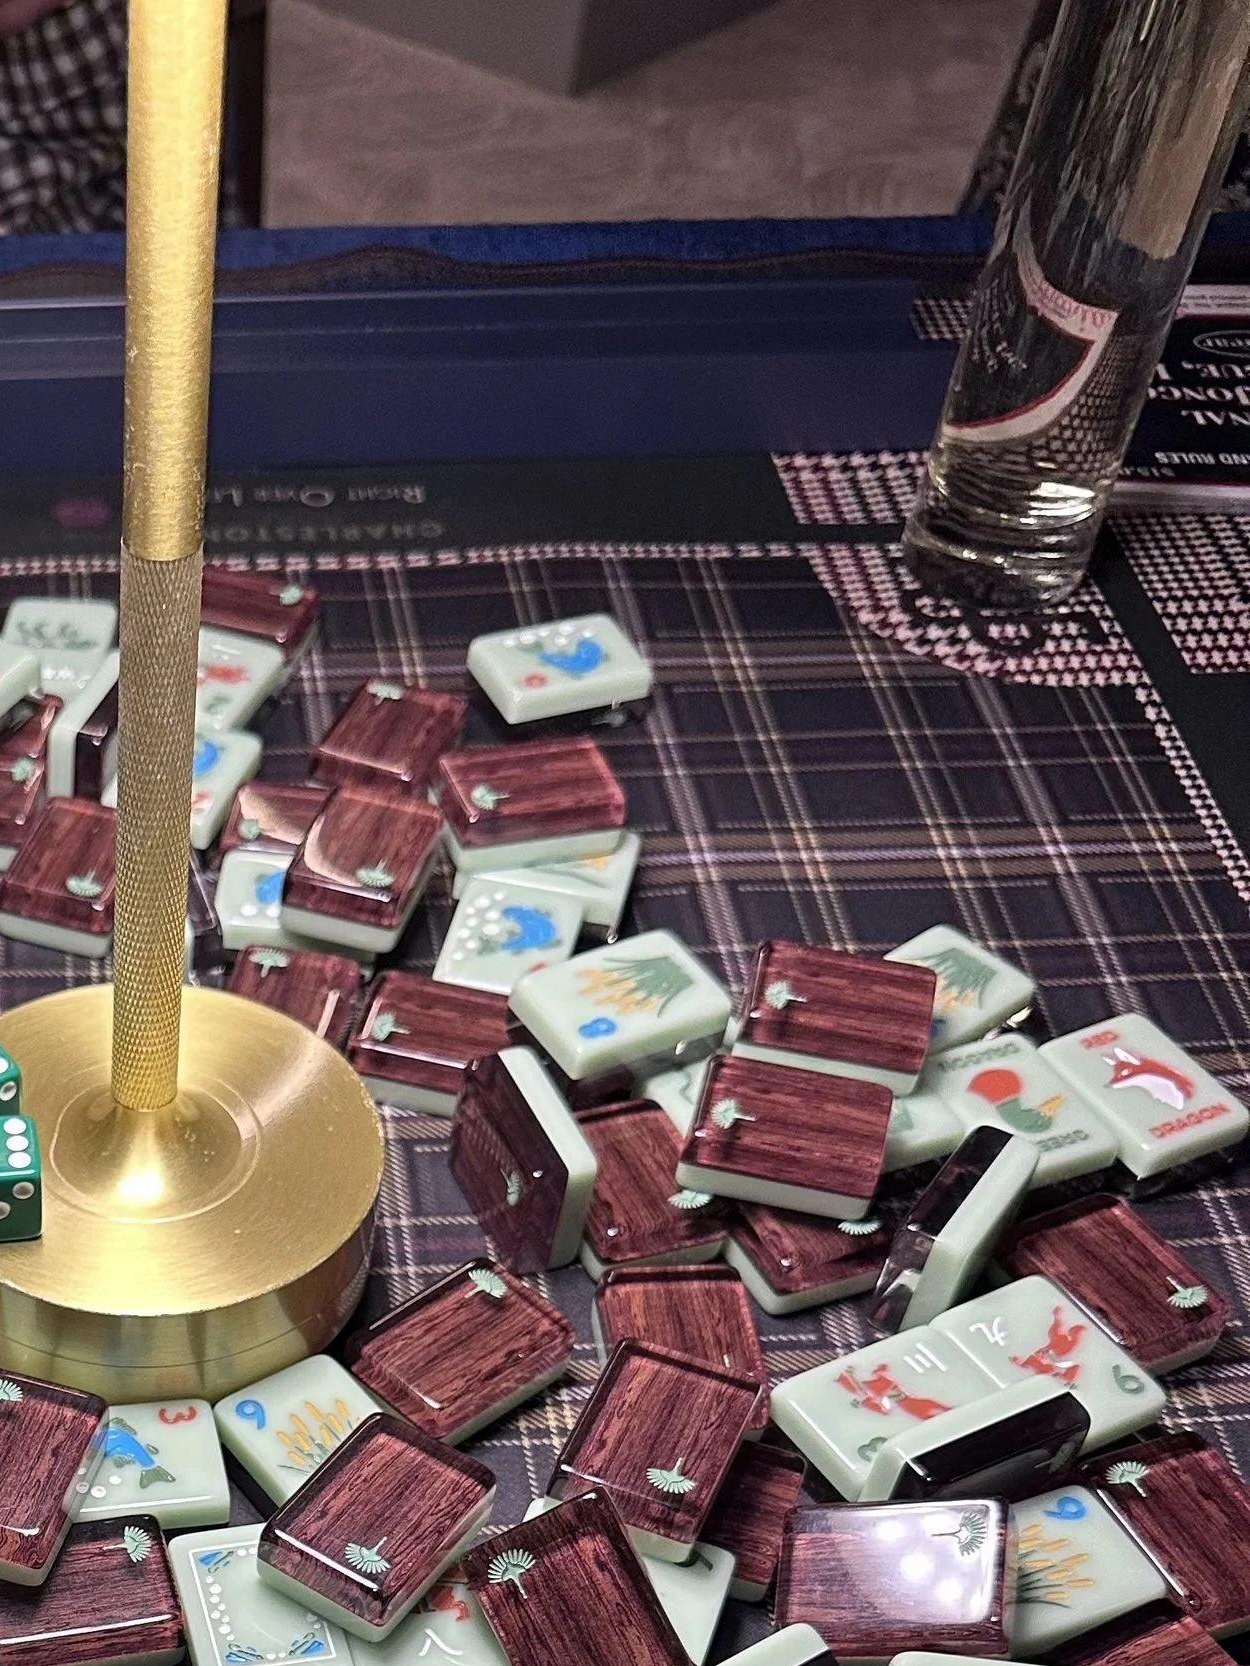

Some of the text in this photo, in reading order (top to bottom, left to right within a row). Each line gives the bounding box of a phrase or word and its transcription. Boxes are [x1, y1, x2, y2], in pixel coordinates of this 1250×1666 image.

[1154, 451, 1215, 466] RULES
[1038, 1128, 1093, 1152] GREE
[158, 1406, 198, 1427] 3
